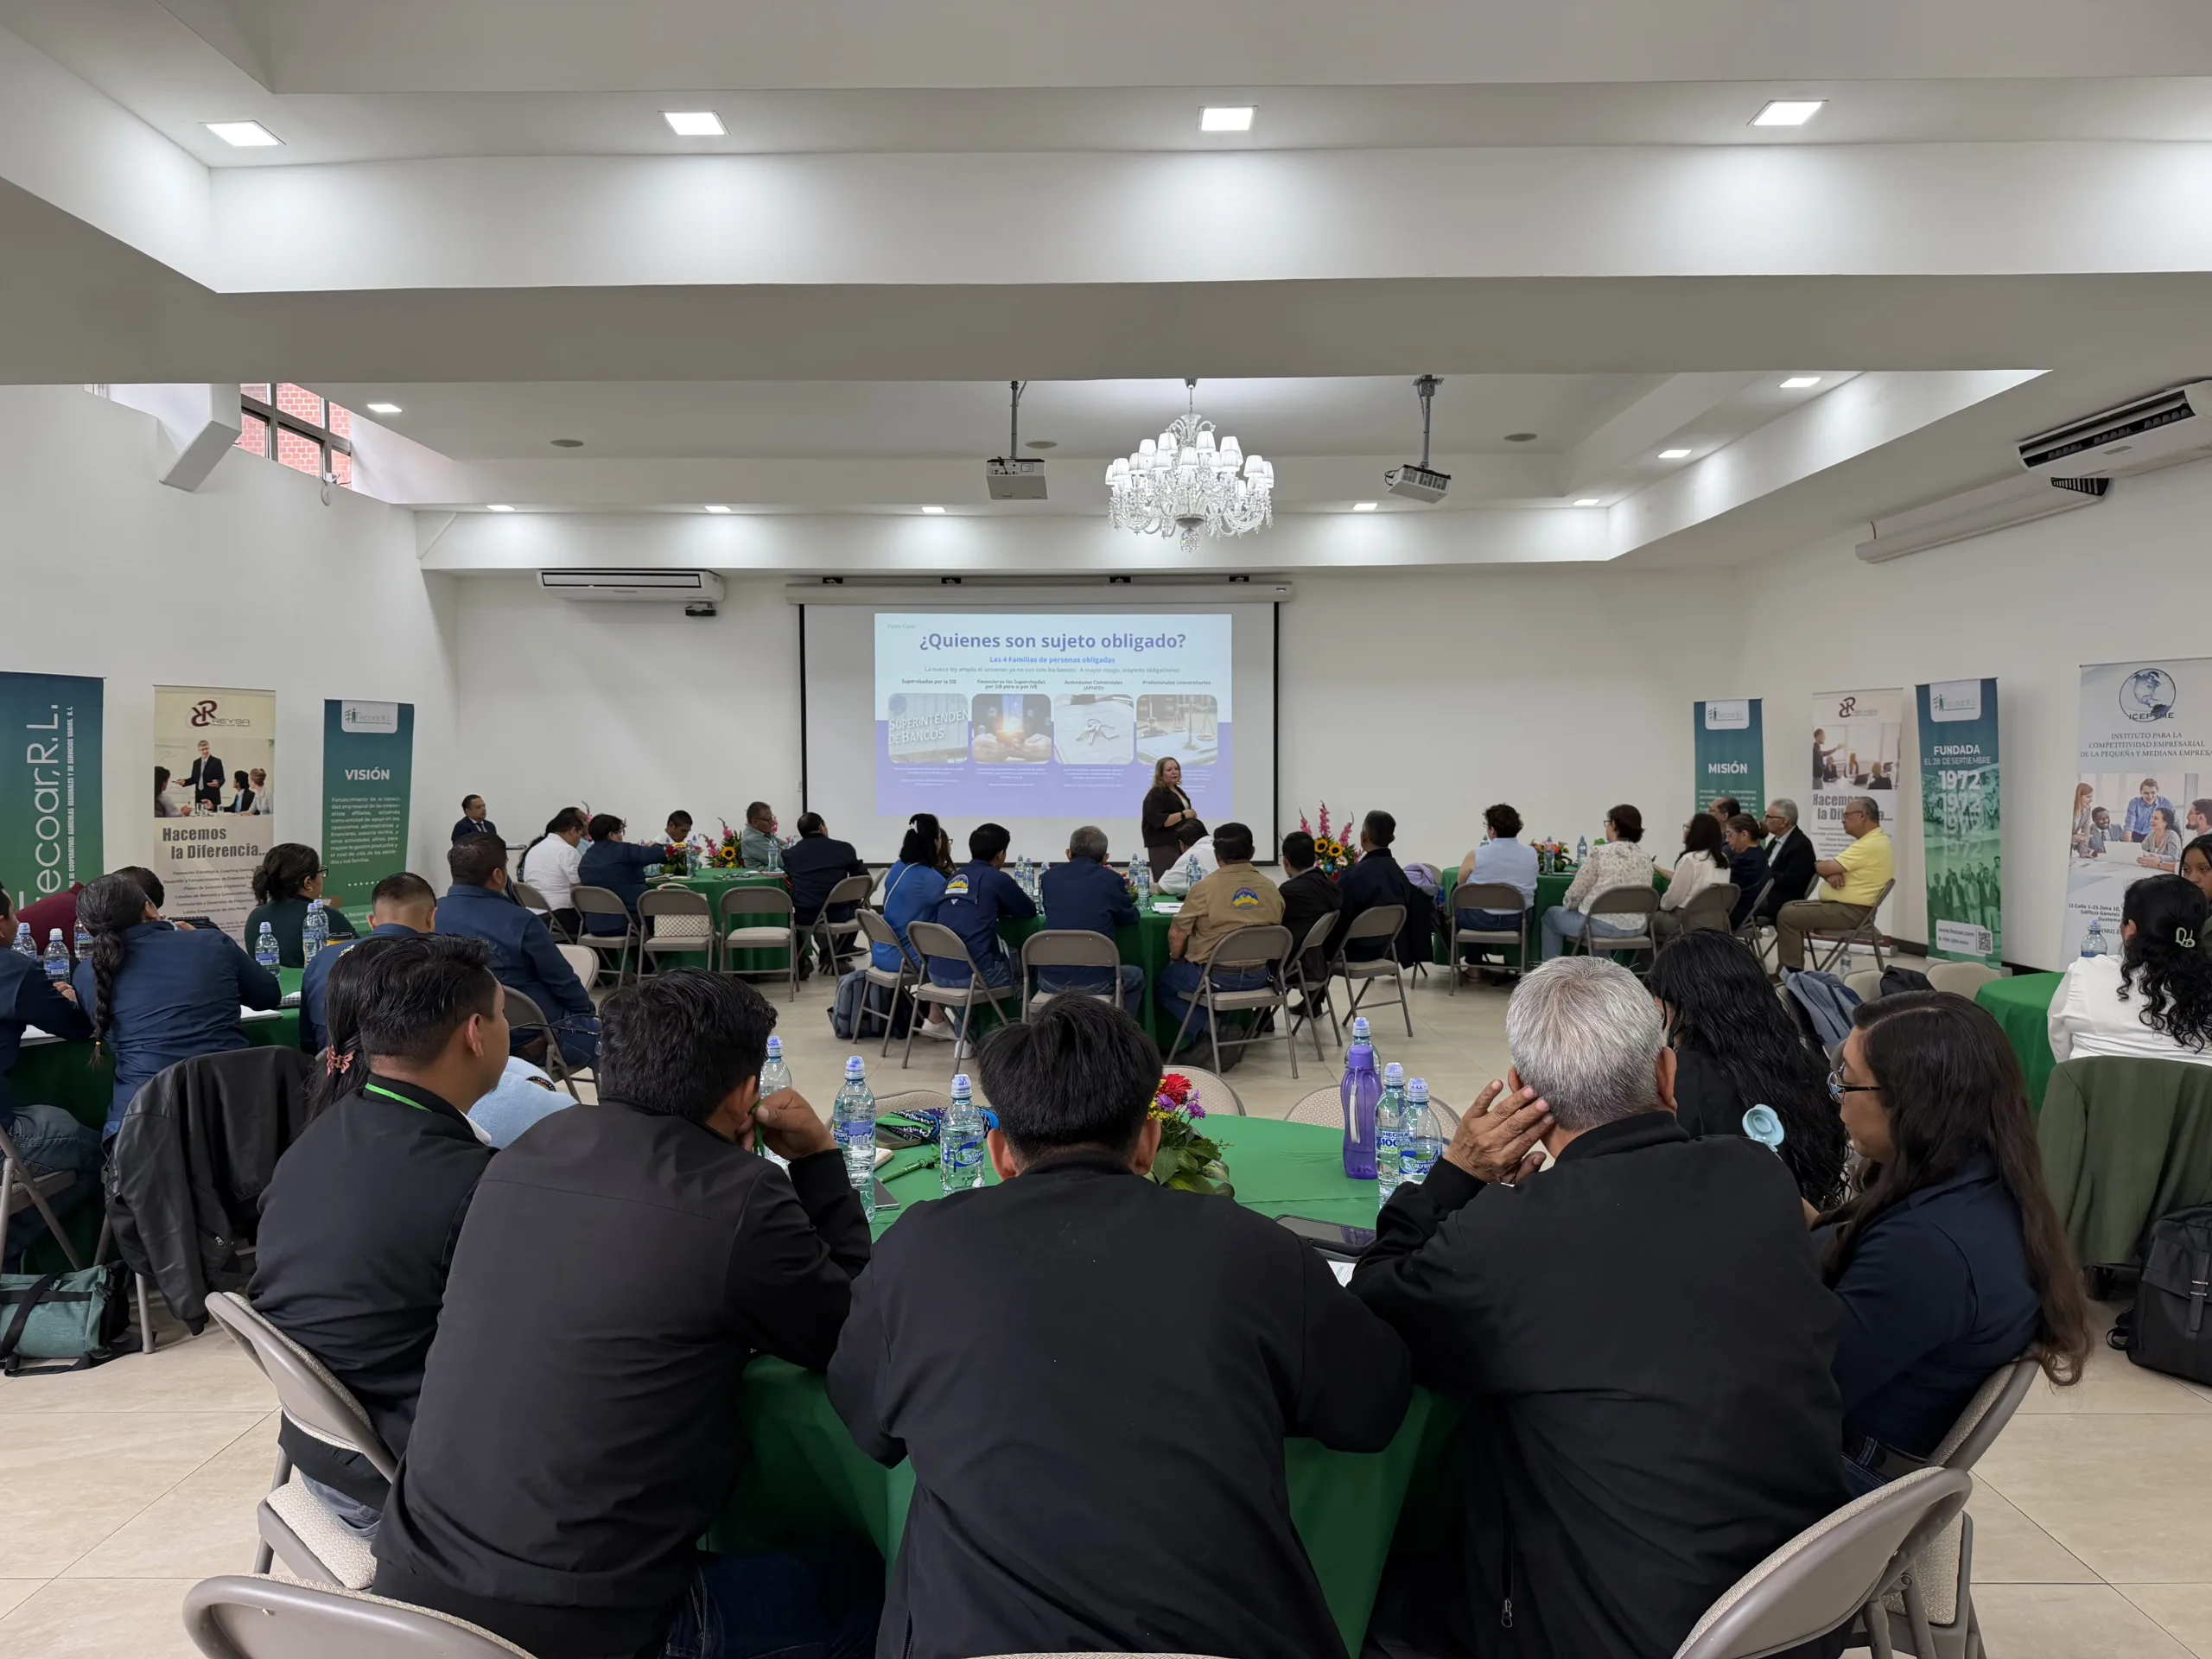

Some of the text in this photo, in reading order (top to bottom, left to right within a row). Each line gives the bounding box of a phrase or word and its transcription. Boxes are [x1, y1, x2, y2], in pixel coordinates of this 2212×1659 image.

[919, 632, 1186, 652] ¿Quienes son sujeto obligado?
[1934, 744, 1980, 756] FUNDADA
[2101, 749, 2134, 758] PEQUEÑA
[1708, 760, 1748, 774] MISIÓN
[1950, 756, 1991, 765] SEPTIEMBRE
[345, 766, 390, 780] VISIÓN
[1938, 770, 1980, 790] 1972
[1940, 791, 1981, 813] 1972
[1817, 808, 1828, 820] la
[162, 827, 226, 842] Hacemos
[171, 845, 183, 860] la
